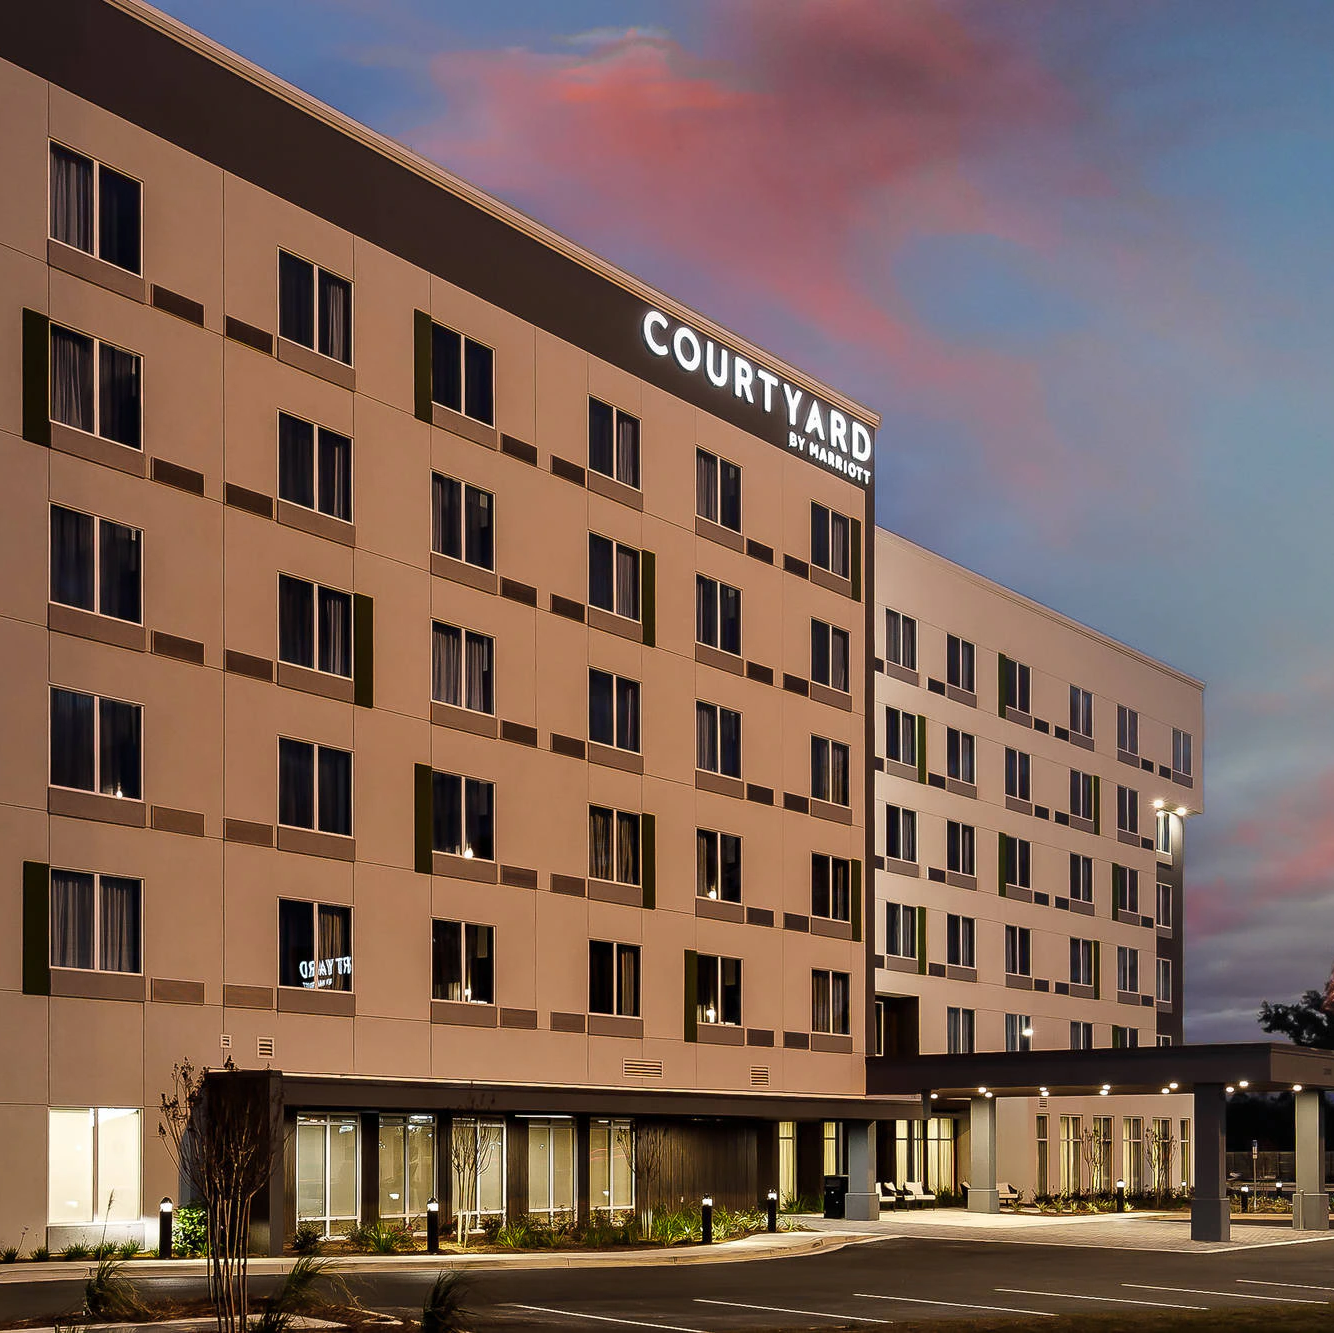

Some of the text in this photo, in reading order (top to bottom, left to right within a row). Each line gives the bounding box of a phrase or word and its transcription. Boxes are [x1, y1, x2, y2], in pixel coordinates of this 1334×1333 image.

[643, 310, 872, 462] COURTYARD
[788, 431, 871, 485] BY MARRIOTT
